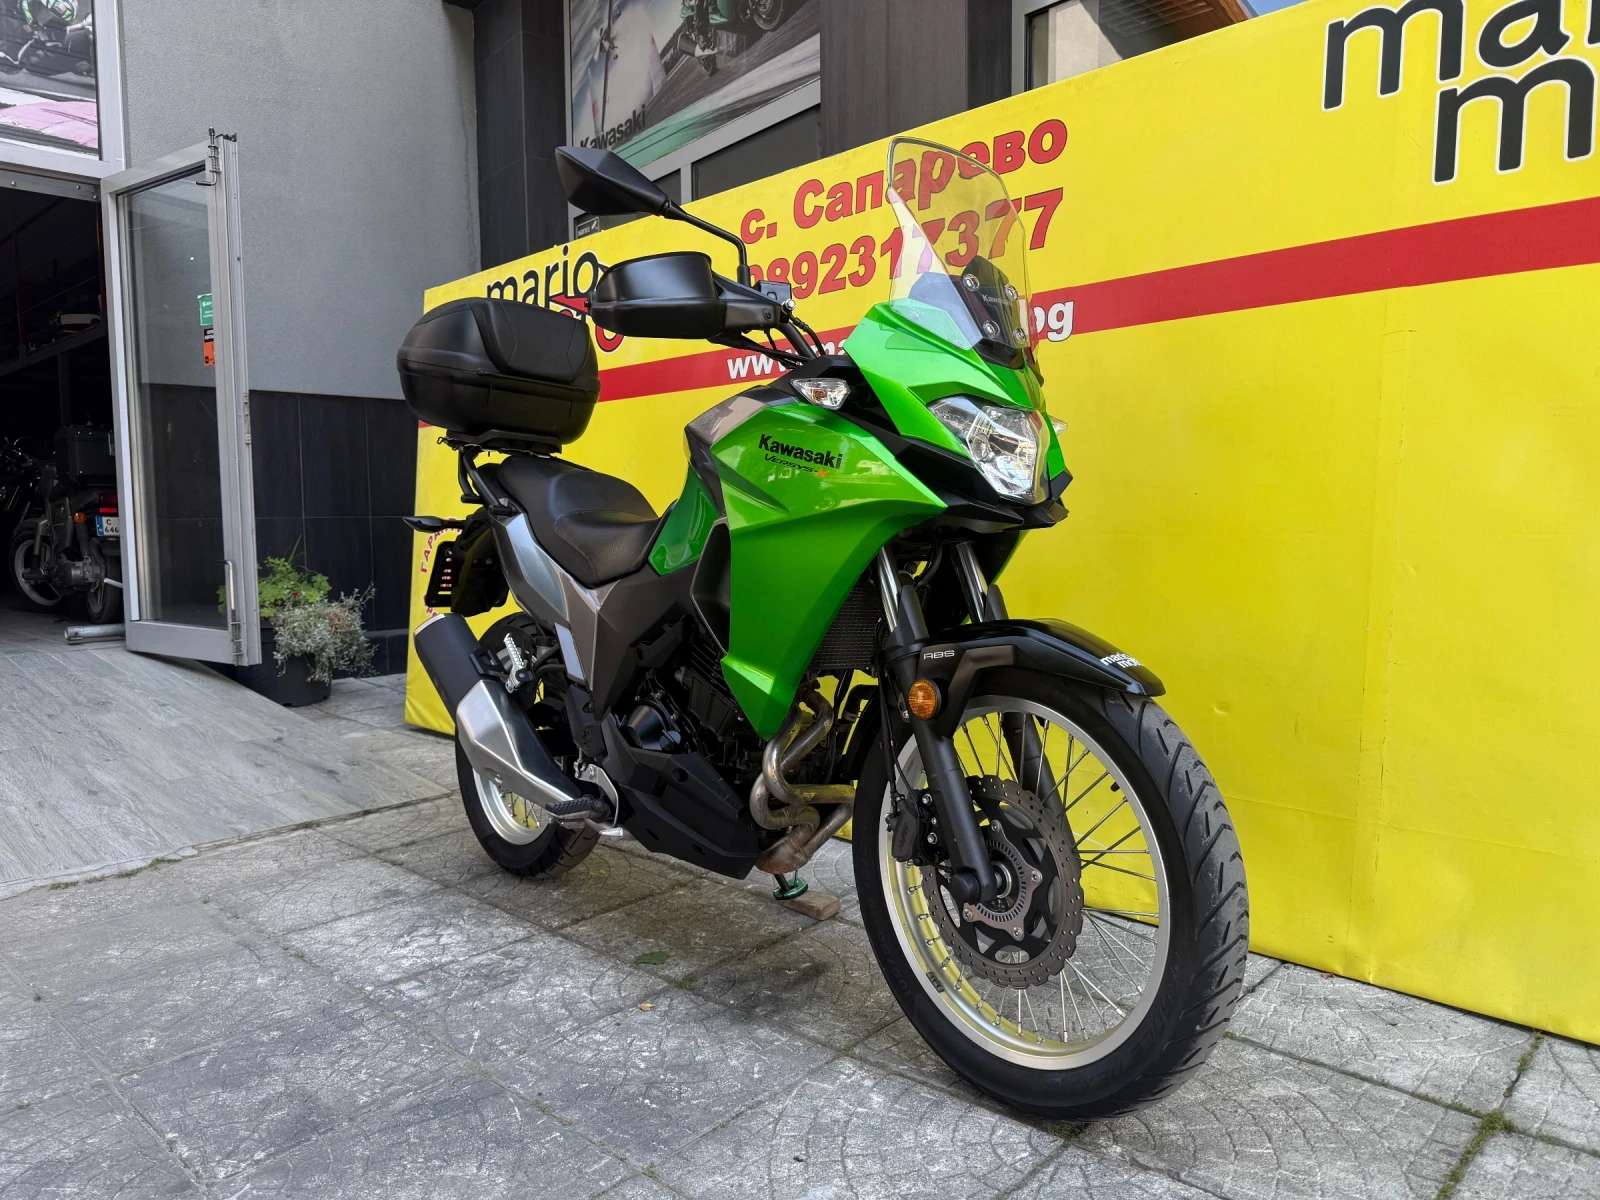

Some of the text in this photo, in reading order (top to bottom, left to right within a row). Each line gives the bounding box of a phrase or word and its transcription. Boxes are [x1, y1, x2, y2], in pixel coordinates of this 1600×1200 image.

[793, 118, 1068, 229] Сапарево
[486, 245, 599, 309] mario
[758, 433, 843, 470] Kawasaki
[923, 649, 955, 660] ABS
